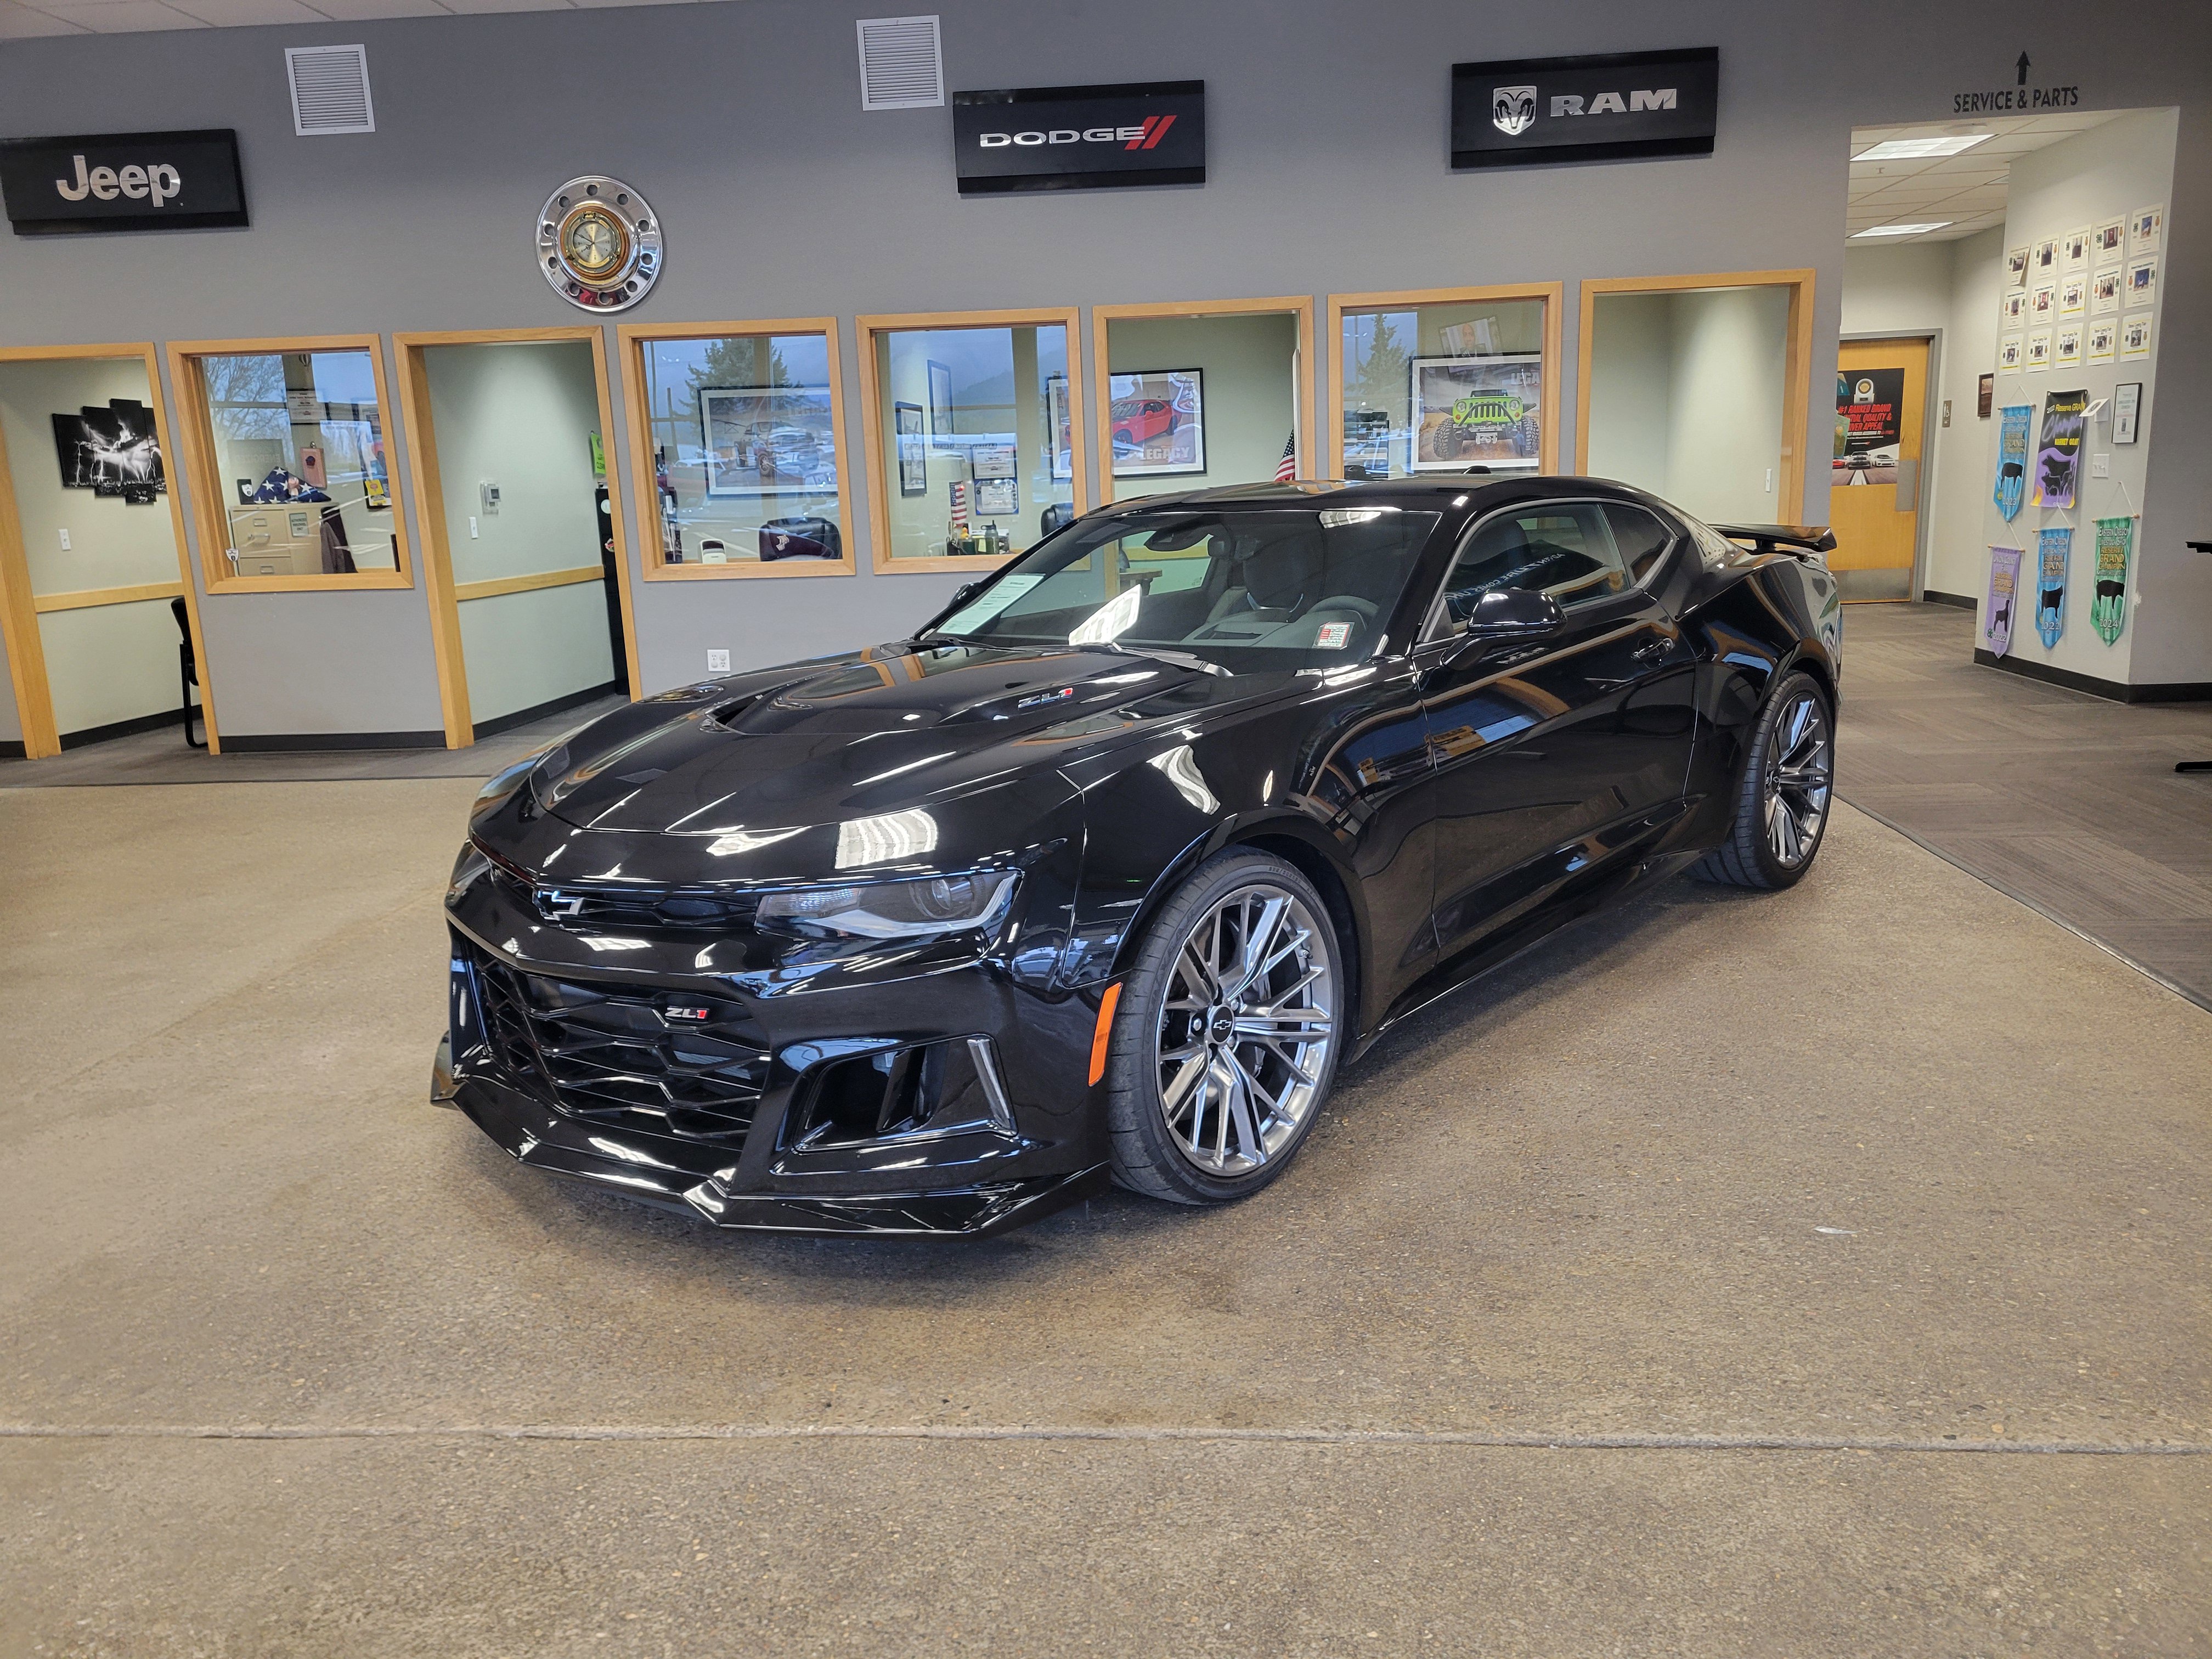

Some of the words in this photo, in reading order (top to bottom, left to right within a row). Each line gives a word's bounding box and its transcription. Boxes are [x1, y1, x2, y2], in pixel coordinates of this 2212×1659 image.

[1550, 88, 1677, 117] RAM
[1954, 91, 2013, 113] SERVICE
[2017, 89, 2027, 109] &
[2033, 86, 2078, 108] PARTS
[980, 126, 1146, 147] DODGE
[56, 155, 181, 207] Jeep
[2100, 554, 2125, 563] GRAND
[2100, 618, 2118, 628] 2024
[665, 1007, 707, 1019] ZL1
